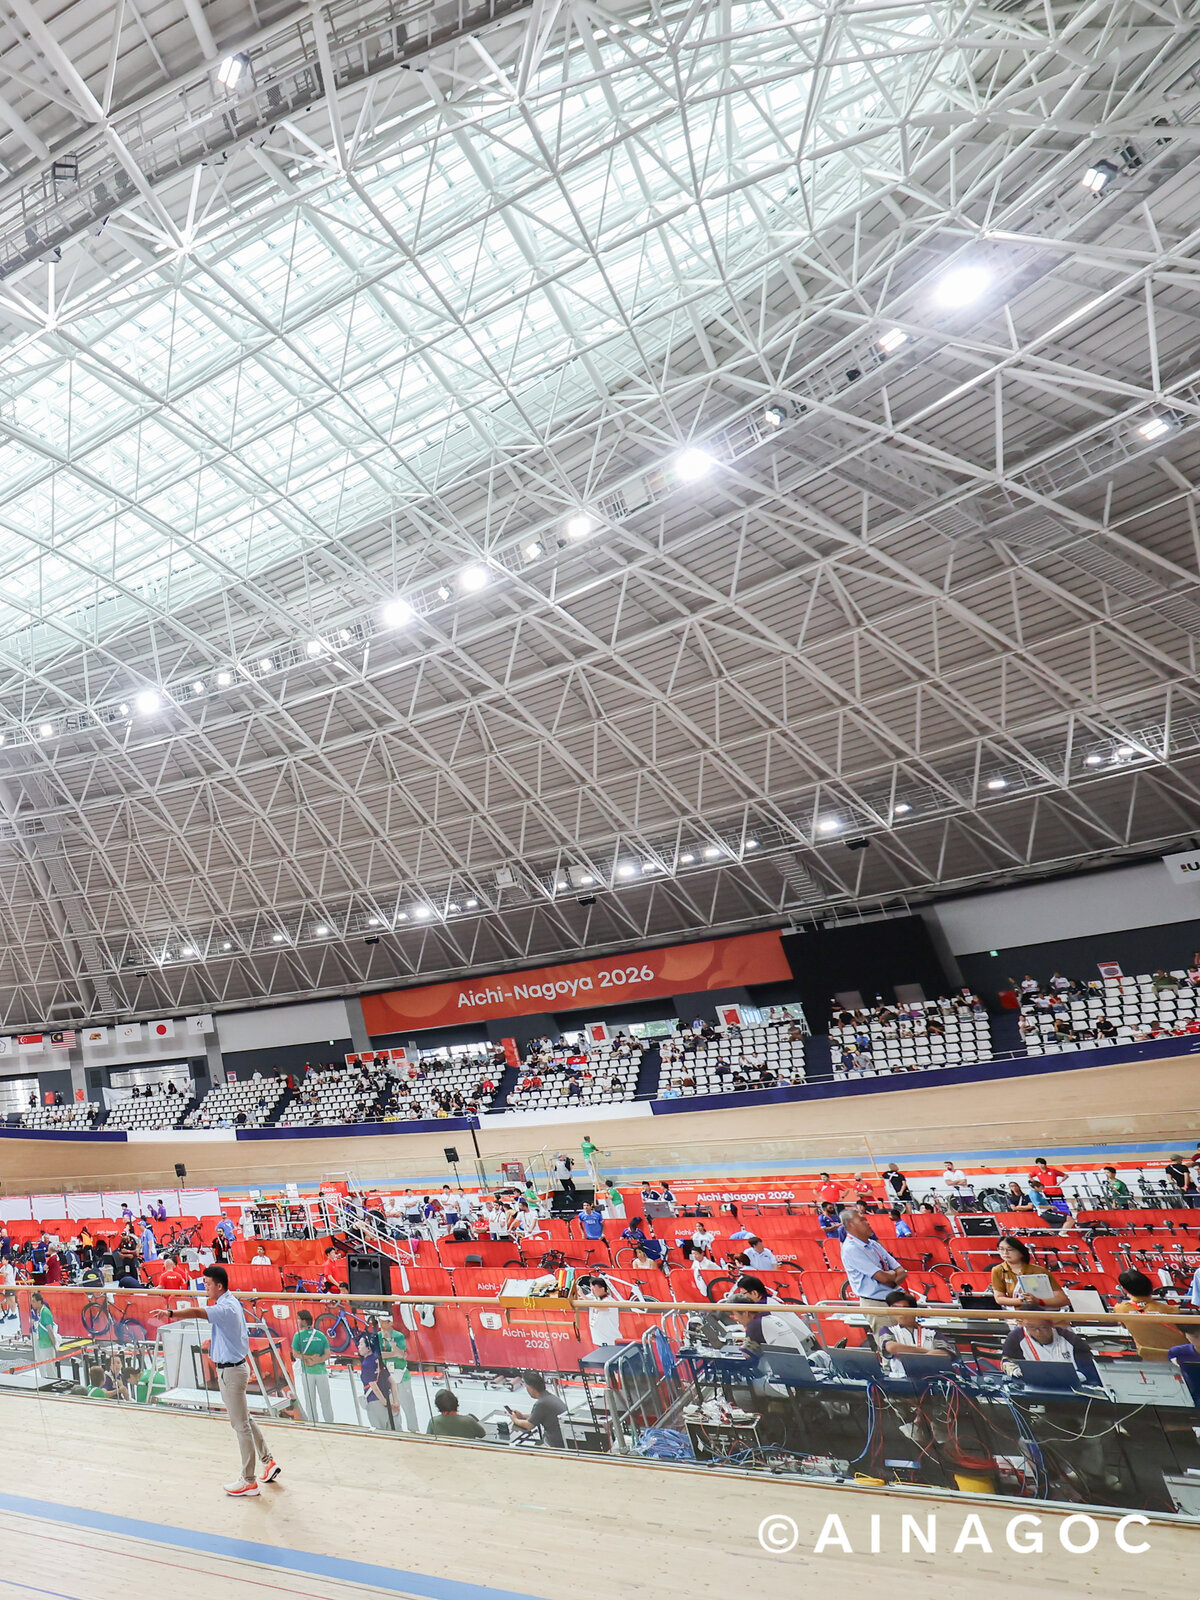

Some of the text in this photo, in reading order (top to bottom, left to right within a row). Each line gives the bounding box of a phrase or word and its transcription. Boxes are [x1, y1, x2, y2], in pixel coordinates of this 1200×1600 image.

[1187, 861, 1200, 871] U
[457, 965, 655, 1008] Aichi-Nagoya 2026
[767, 1191, 795, 1200] 2026
[502, 1329, 570, 1342] Aichi-Nagoya
[525, 1339, 550, 1349] 2026
